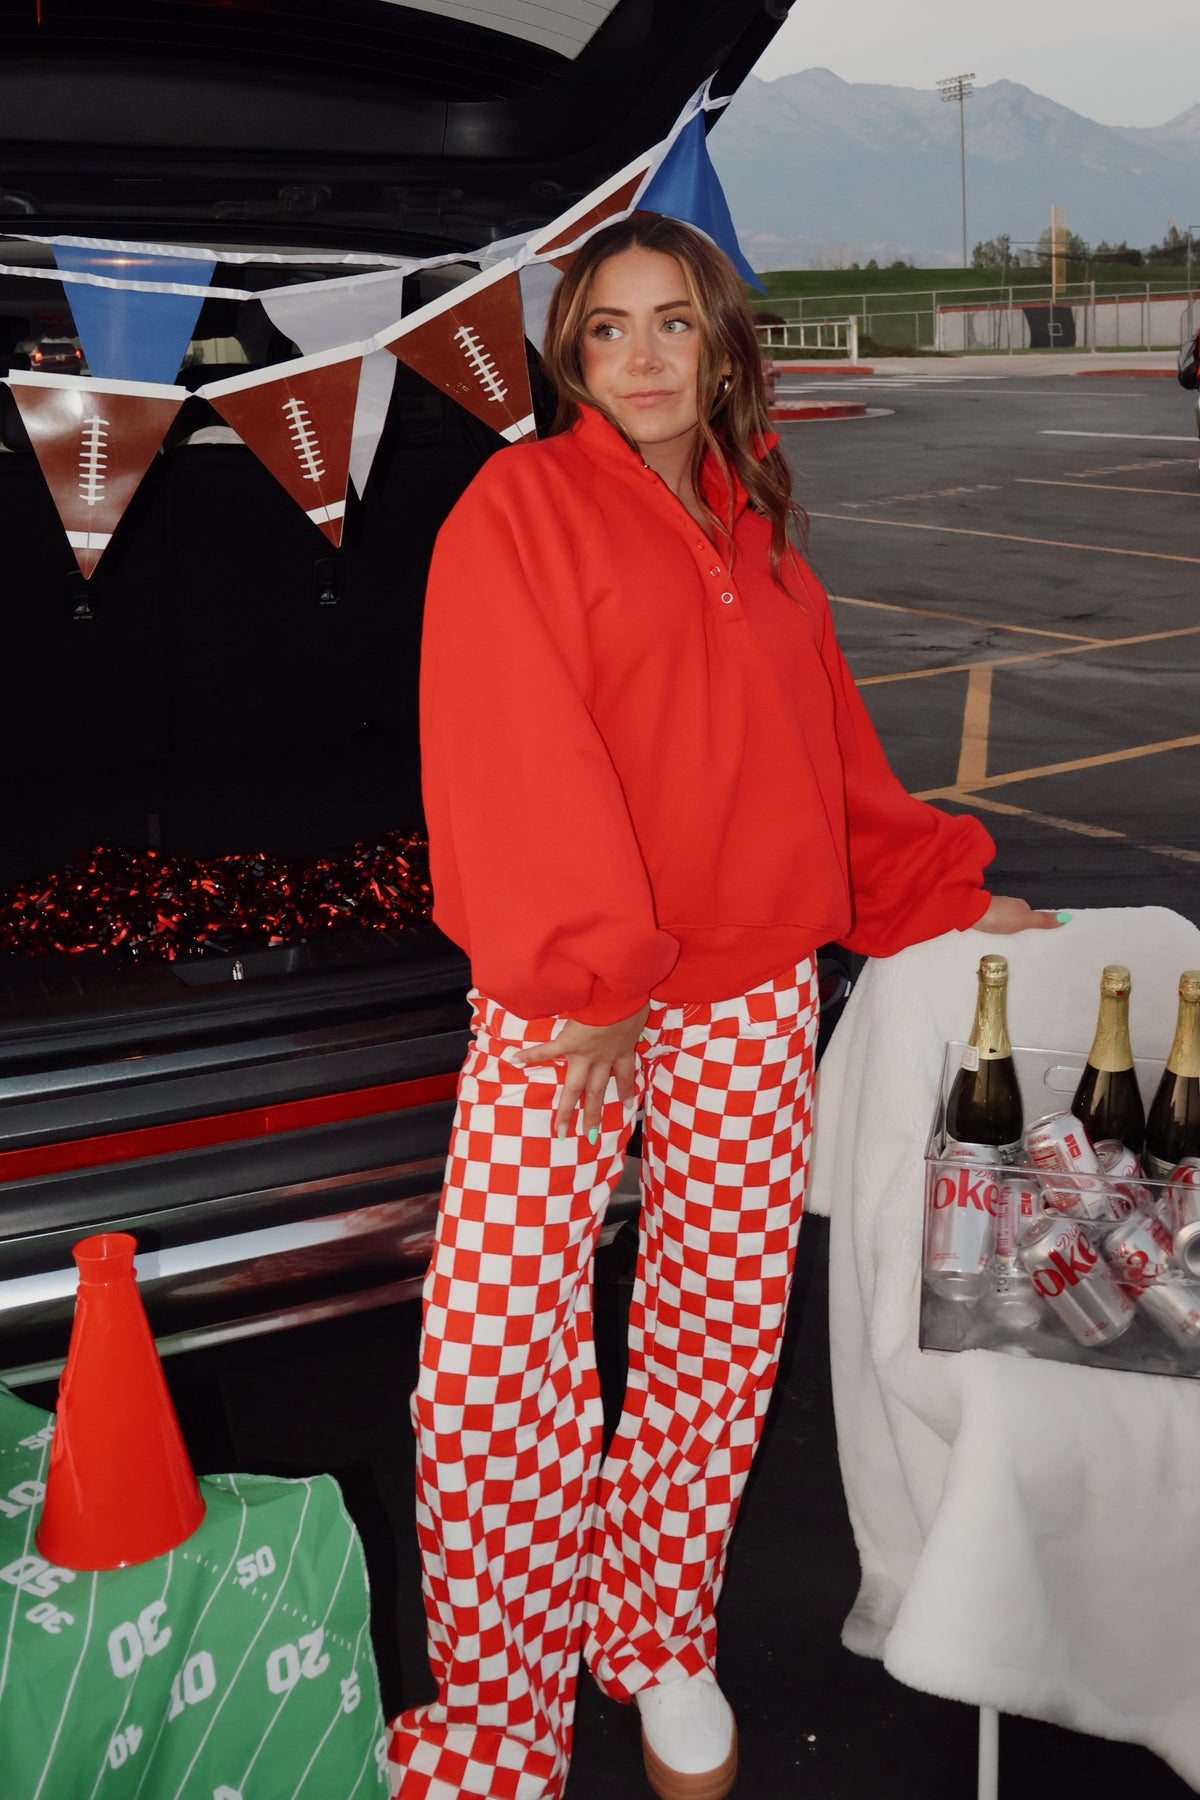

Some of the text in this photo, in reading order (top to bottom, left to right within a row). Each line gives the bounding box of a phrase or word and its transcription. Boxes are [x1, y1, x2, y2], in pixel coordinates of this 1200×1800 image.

[1033, 1231, 1098, 1298] oke
[237, 1546, 276, 1589] 50
[25, 1601, 75, 1634] 30
[108, 1600, 172, 1679] 30
[266, 1625, 330, 1694] 20
[108, 1724, 144, 1770] 40
